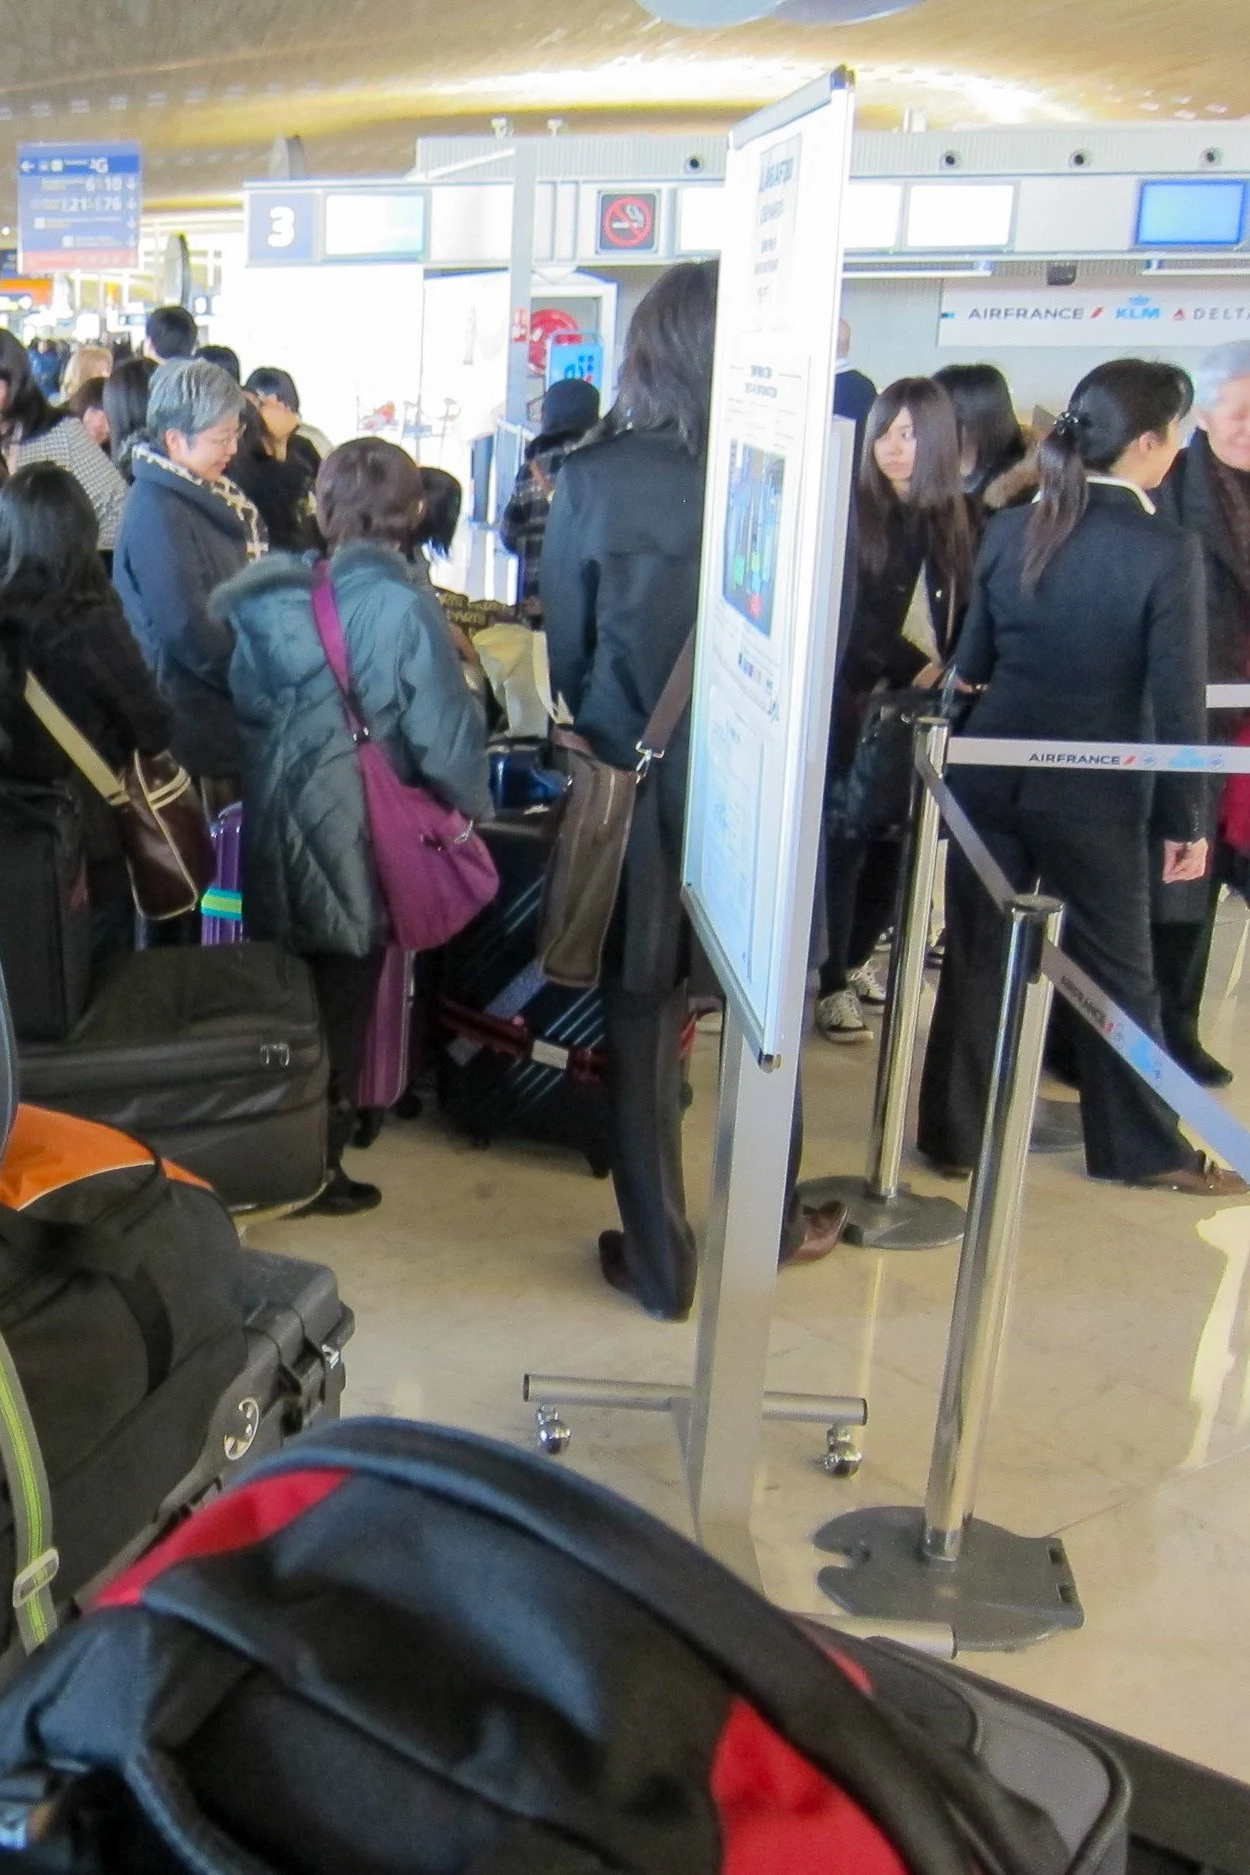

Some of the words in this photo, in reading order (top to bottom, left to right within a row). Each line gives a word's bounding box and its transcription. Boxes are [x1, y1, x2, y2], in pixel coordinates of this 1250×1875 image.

[268, 206, 295, 247] 3
[968, 307, 1084, 320] AIRFRANCE
[1115, 307, 1160, 320] KLM
[1029, 752, 1121, 766] AIRFRANCE
